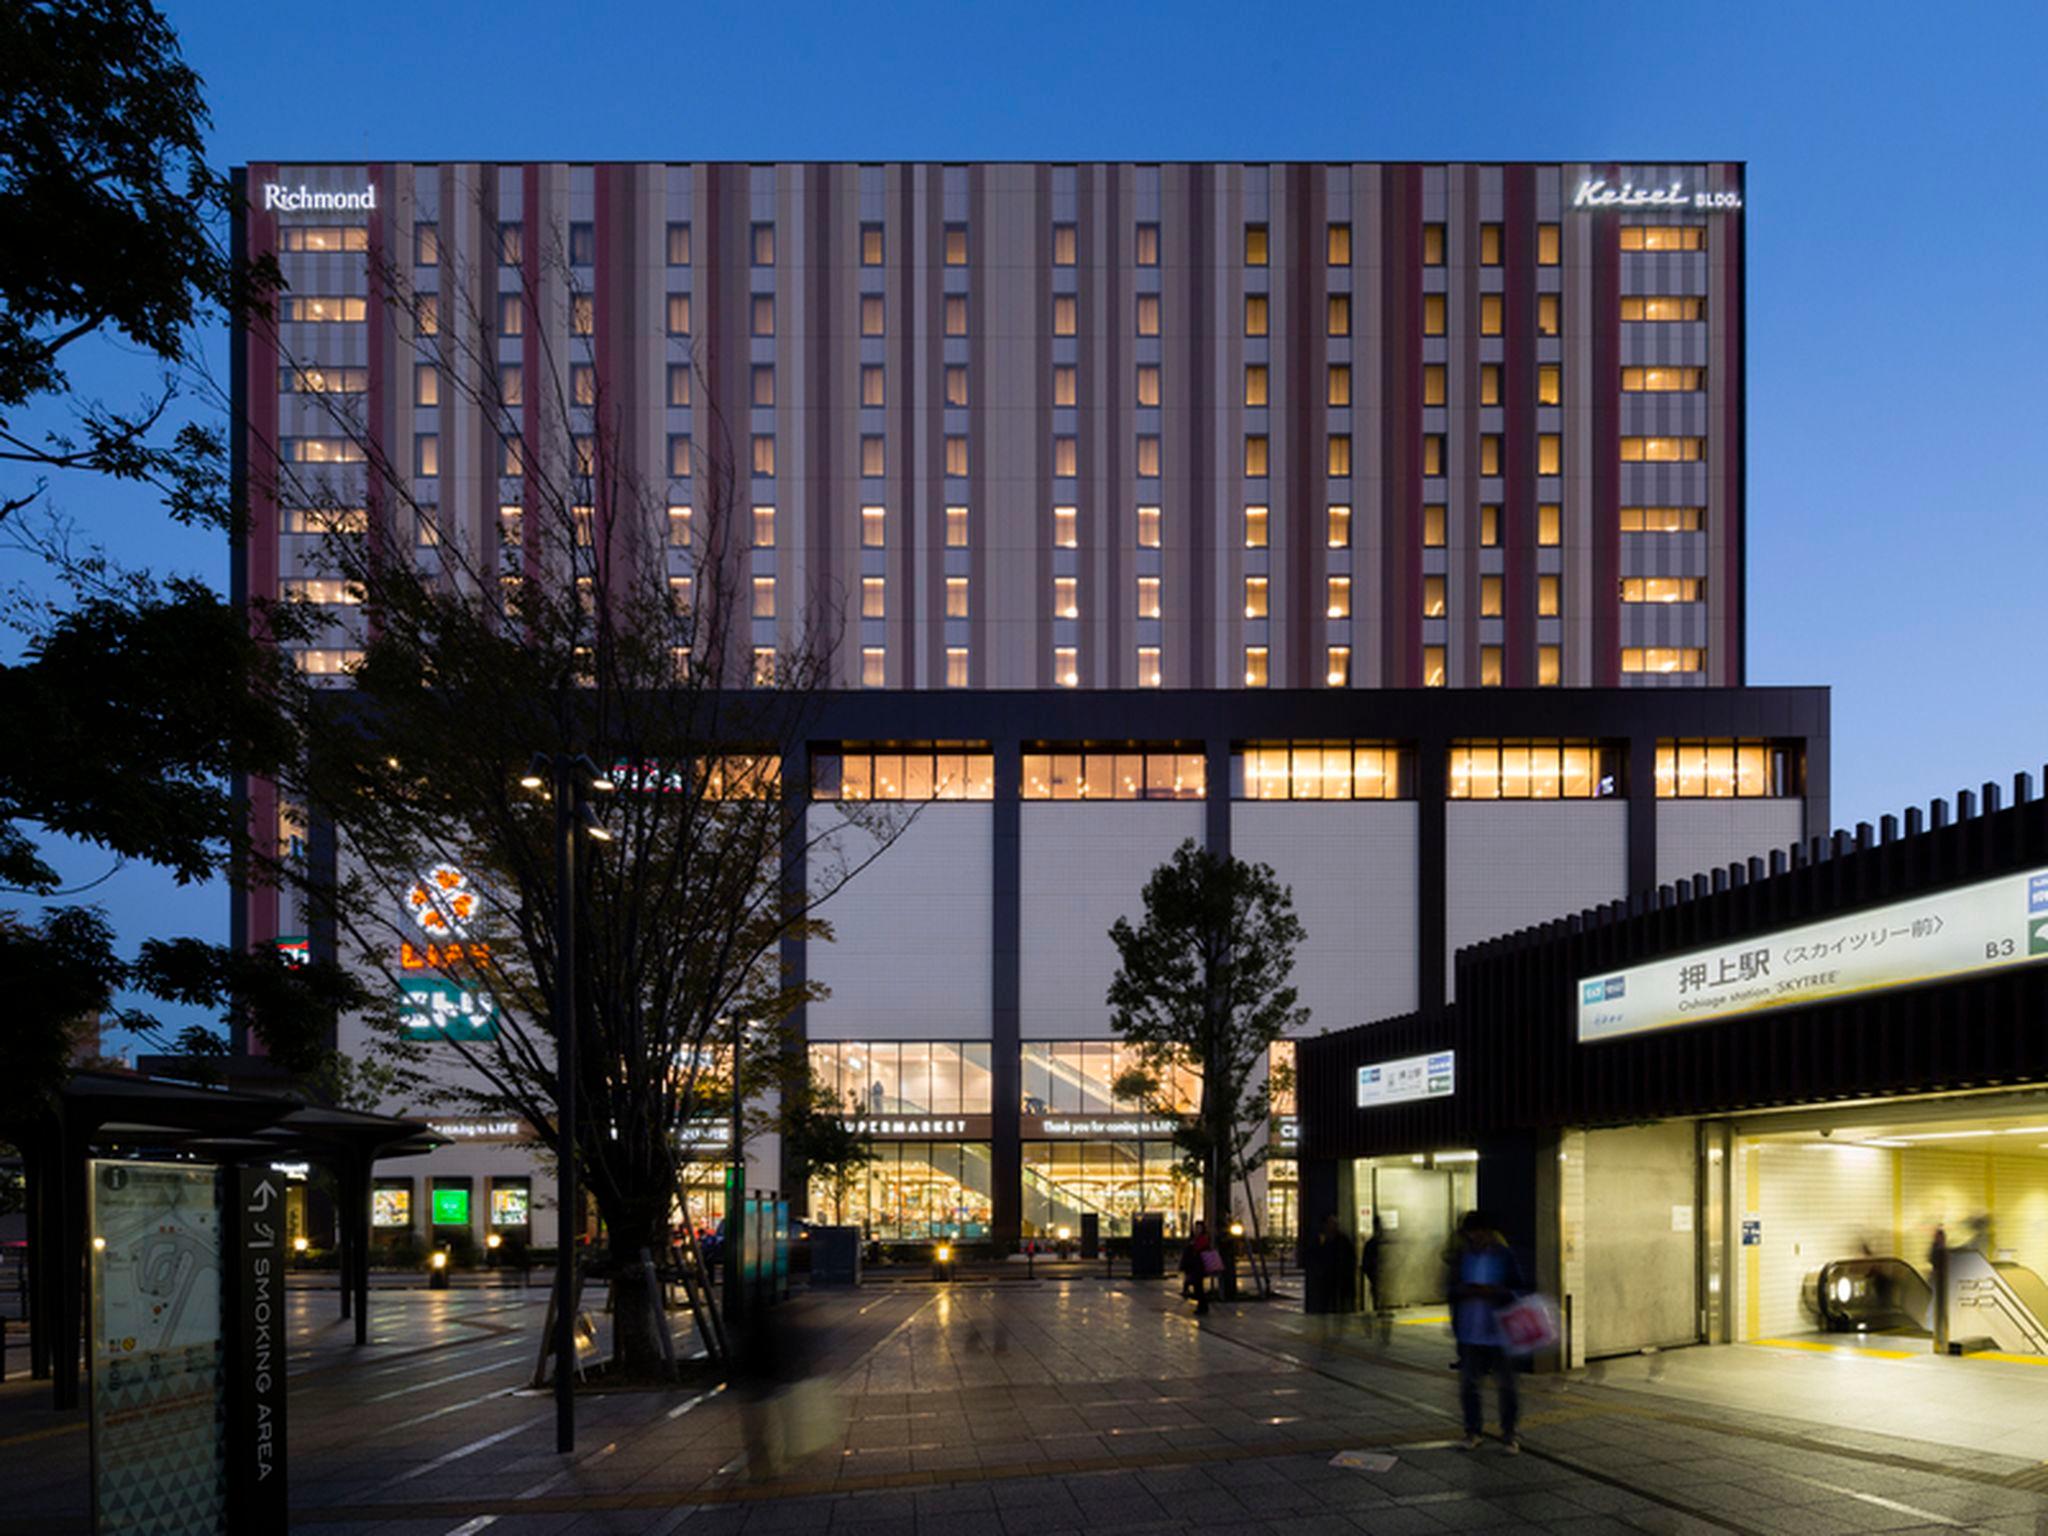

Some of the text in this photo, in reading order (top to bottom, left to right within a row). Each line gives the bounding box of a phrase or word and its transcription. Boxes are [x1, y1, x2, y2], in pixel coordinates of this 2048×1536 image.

[264, 183, 376, 211] Richmond
[1573, 179, 1690, 206] Keisei
[1985, 937, 2015, 959] B3
[1679, 948, 1770, 994] 押上駅
[836, 1120, 966, 1133] UPERMARKET
[254, 1257, 273, 1482] SMOKING AREA
